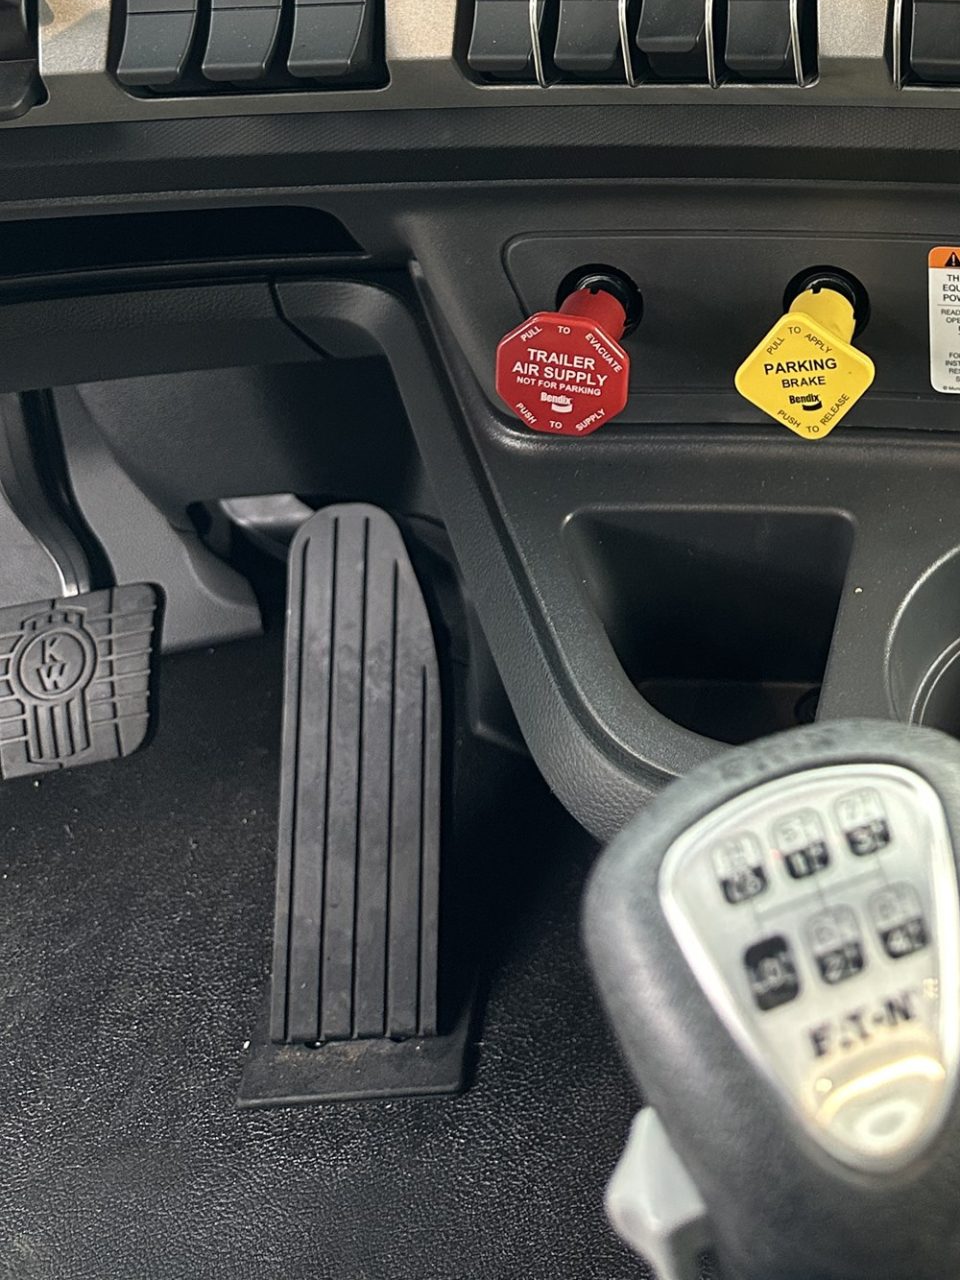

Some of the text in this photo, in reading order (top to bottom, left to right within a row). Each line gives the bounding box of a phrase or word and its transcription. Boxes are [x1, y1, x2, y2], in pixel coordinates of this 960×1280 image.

[520, 325, 623, 373] PULL TO EVACUATE
[766, 326, 833, 355] PULL TO APPLY
[527, 347, 595, 370] TRAILER
[764, 357, 837, 375] PARKING
[512, 361, 608, 387] AIR SUPPLY
[516, 375, 601, 396] NOT FOR PARKING
[782, 375, 826, 389] BRAKE
[540, 392, 572, 406] Bendix
[789, 393, 820, 405] Bendix
[515, 402, 606, 432] PUSH TO SUPPLY
[777, 393, 850, 433] PUSH TO RELEASE
